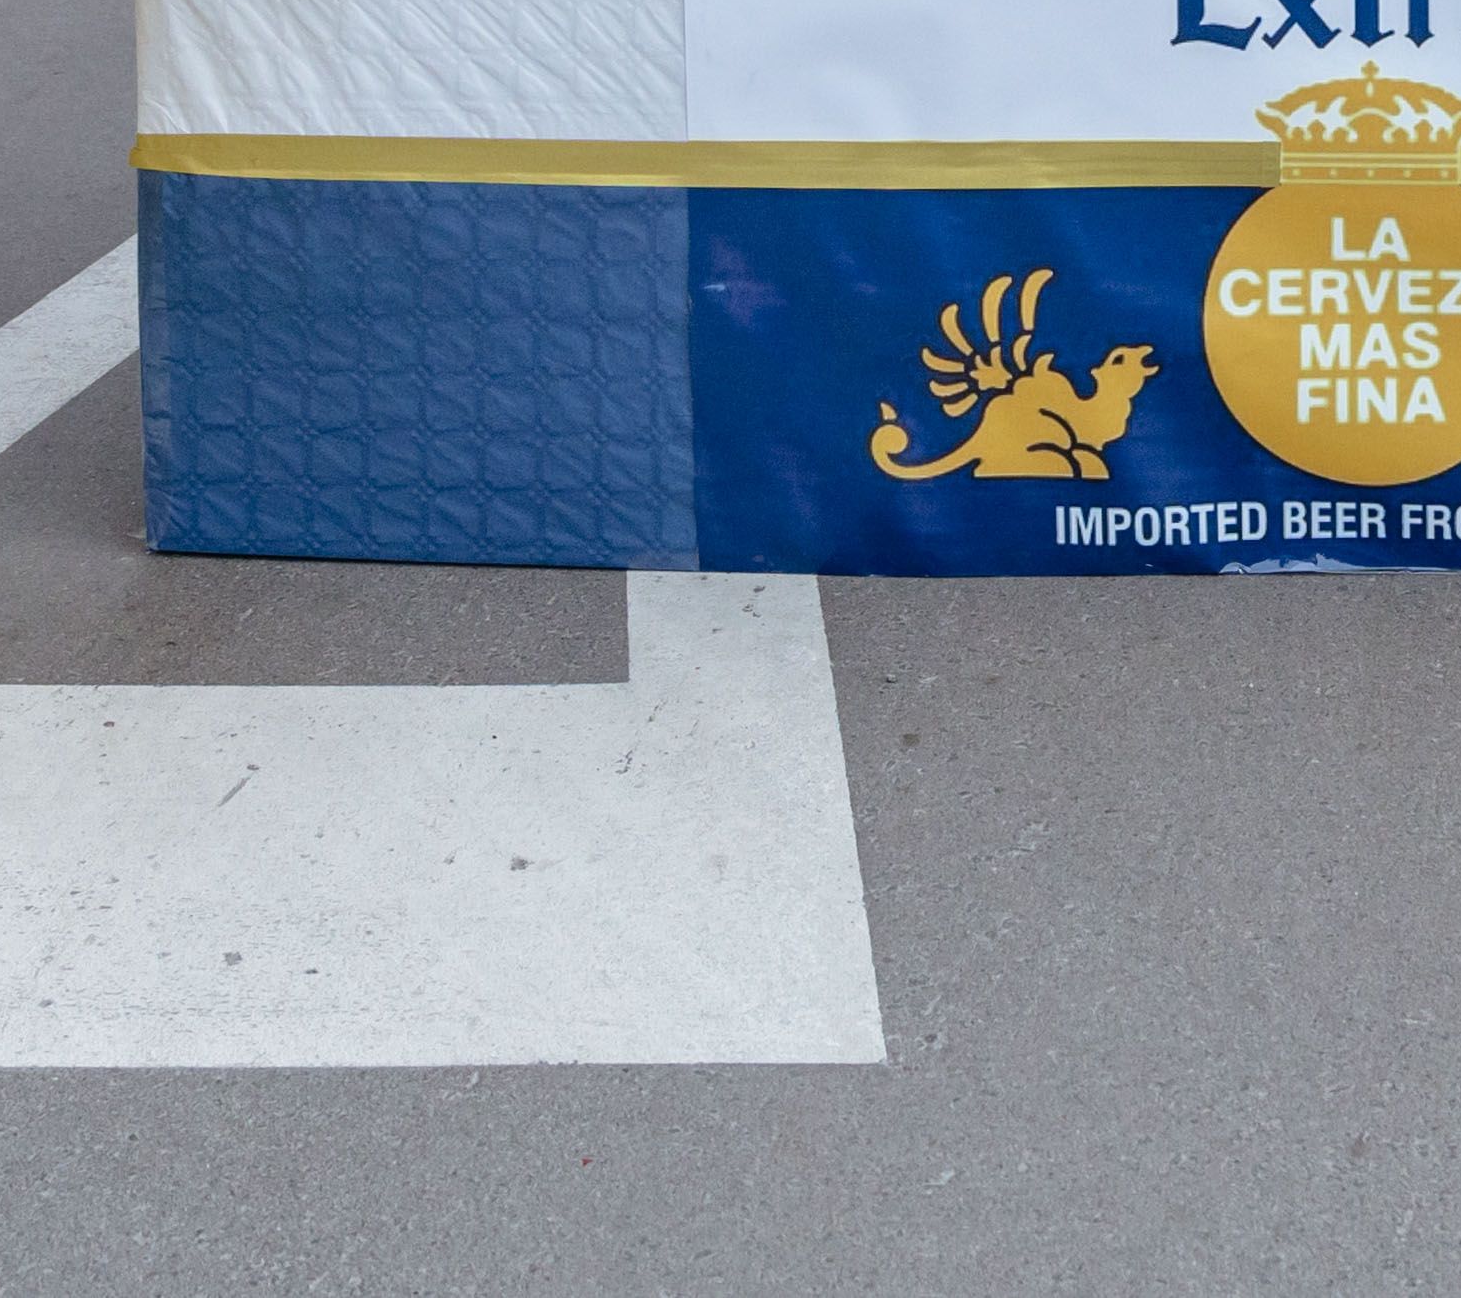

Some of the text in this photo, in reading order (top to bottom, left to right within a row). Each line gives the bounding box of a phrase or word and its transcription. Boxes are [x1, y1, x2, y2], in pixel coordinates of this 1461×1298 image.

[1330, 217, 1411, 264] LA
[1298, 322, 1443, 370] MAS
[1296, 378, 1446, 427] FINA
[1054, 501, 1268, 550] IMPORTED
[1283, 501, 1387, 544] BEER
